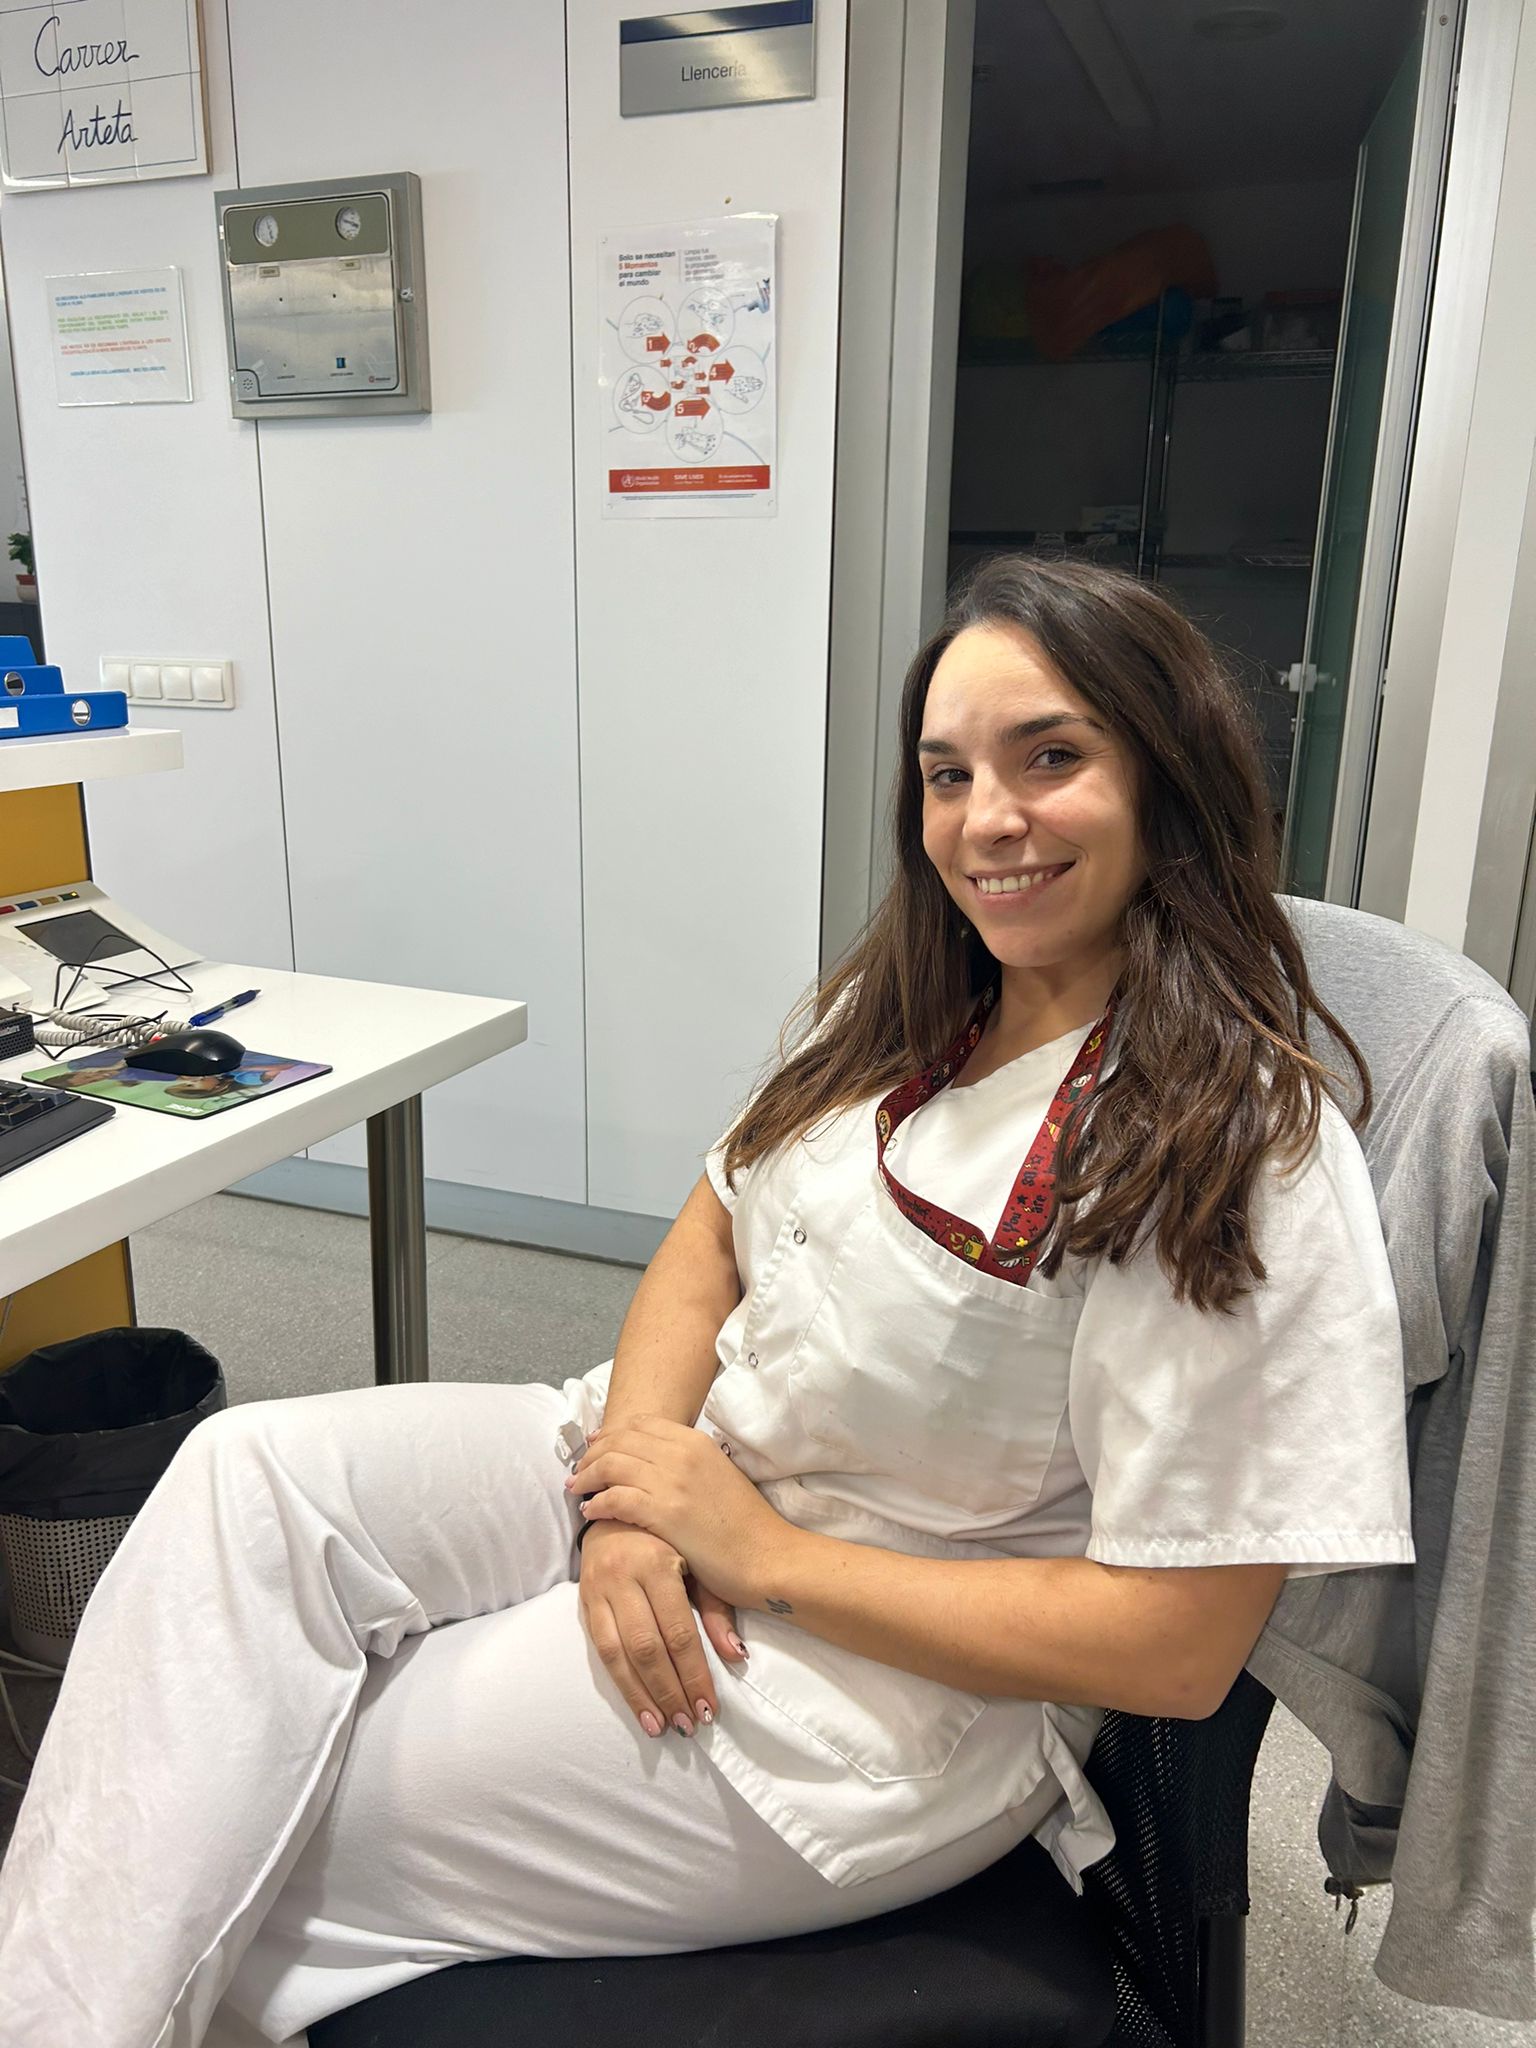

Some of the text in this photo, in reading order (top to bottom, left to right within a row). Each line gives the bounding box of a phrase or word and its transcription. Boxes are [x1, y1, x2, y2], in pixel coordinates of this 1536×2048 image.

[35, 16, 140, 76] Carrer
[57, 99, 138, 154] Arteta
[648, 340, 653, 350] 1
[688, 341, 697, 352] 2
[710, 367, 717, 378] 4
[676, 403, 684, 414] 5
[1002, 1213, 1021, 1233] You
